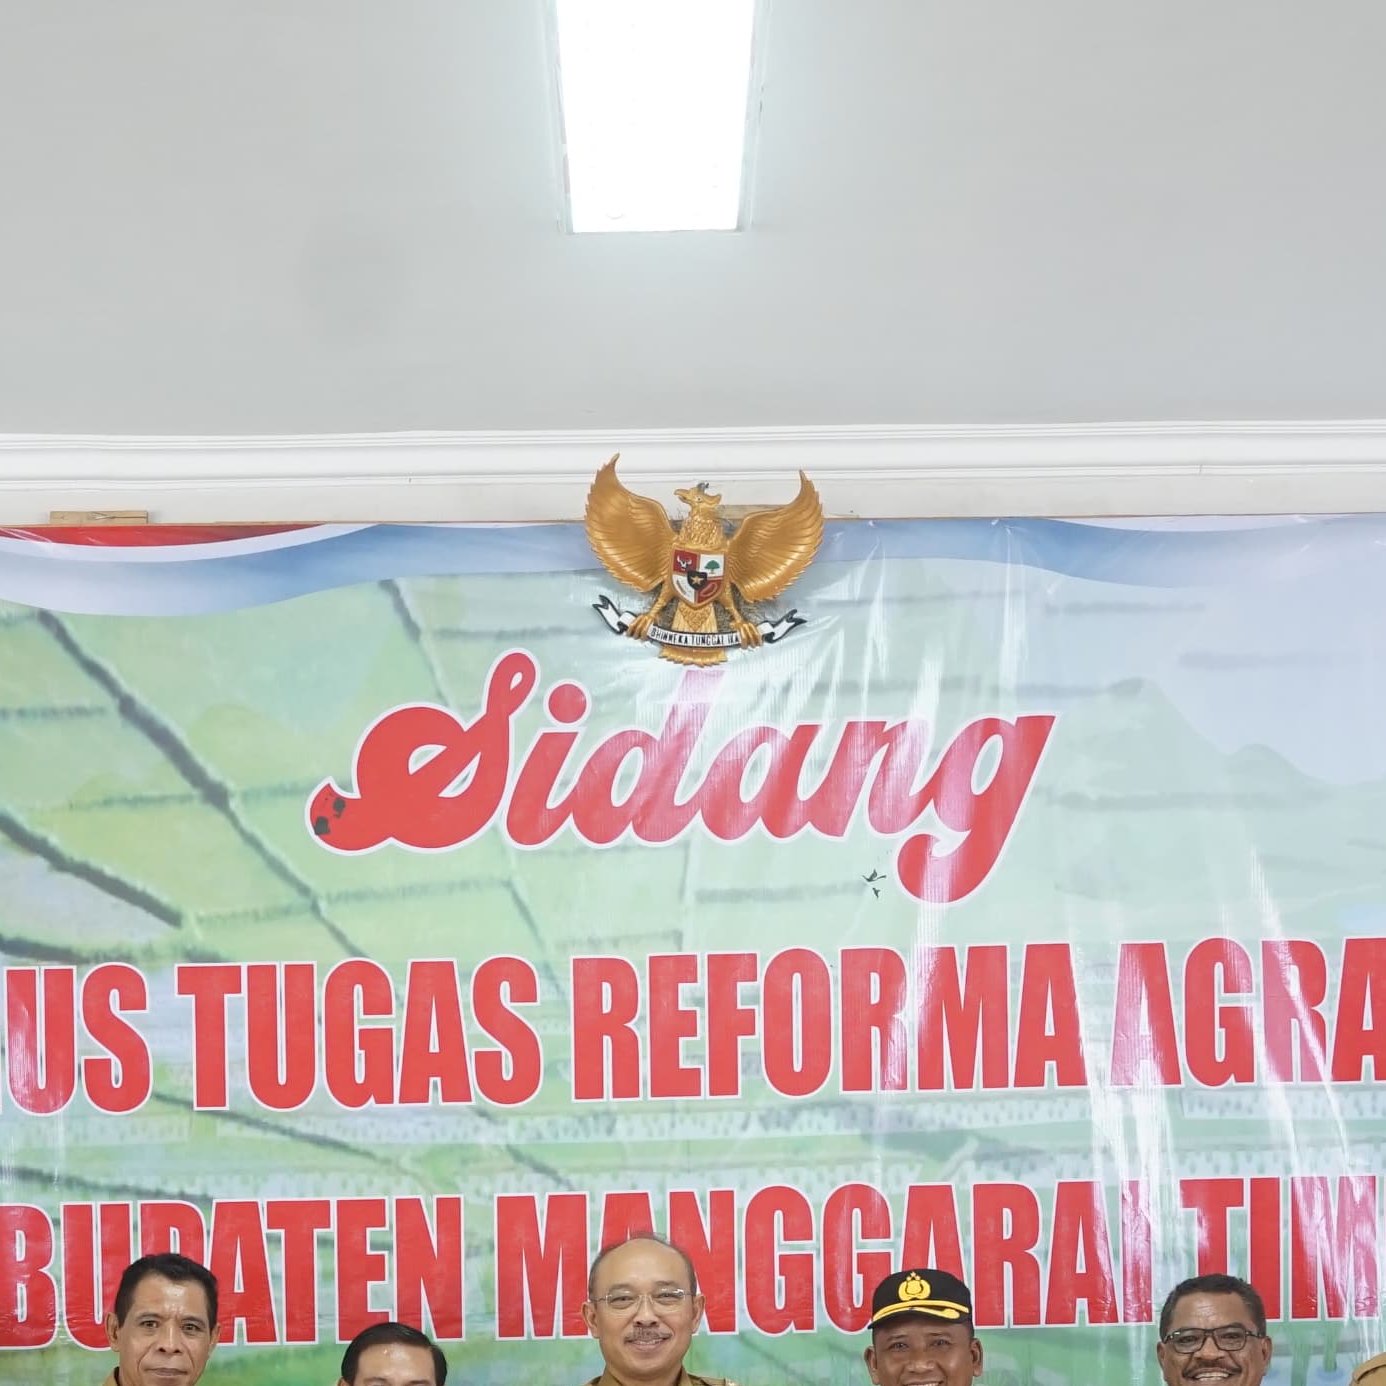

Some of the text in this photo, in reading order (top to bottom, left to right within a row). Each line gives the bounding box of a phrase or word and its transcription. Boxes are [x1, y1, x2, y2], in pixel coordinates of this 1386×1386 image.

[309, 648, 1057, 904] Sidang
[175, 955, 542, 1113] TUGAS
[569, 942, 1087, 1103] REFORMA
